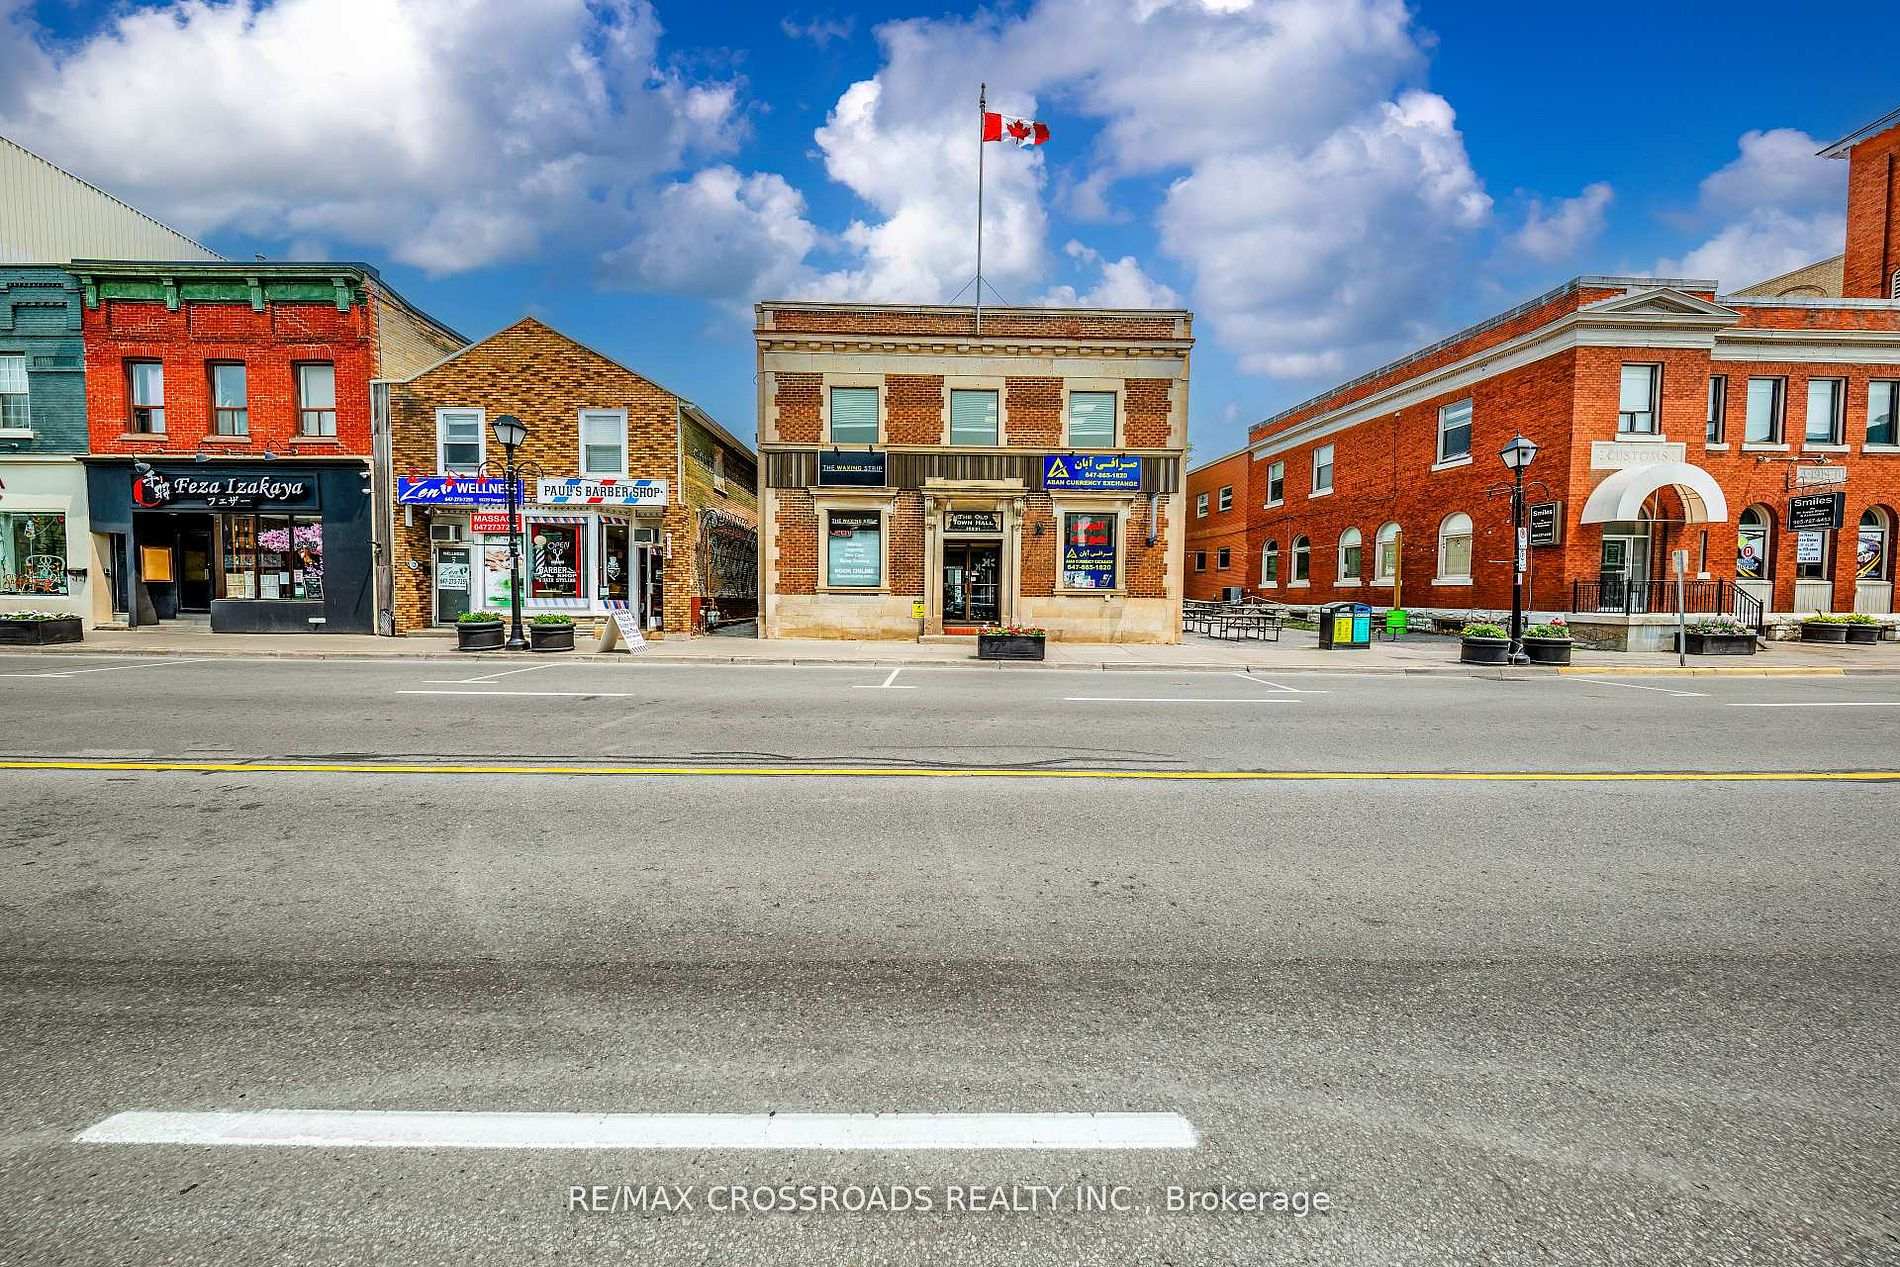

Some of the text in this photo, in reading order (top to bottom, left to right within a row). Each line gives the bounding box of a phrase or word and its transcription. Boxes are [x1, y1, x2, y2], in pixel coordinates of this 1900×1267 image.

[174, 476, 303, 500] Feza Izakaya
[400, 480, 441, 502] Zen
[544, 485, 660, 498] PAUL'S BARBER SHOP
[208, 496, 251, 506] フェザー
[1794, 497, 1833, 507] Smiles
[1532, 509, 1553, 517] Smiles
[547, 541, 570, 550] OPEN
[538, 566, 567, 574] BARBER
